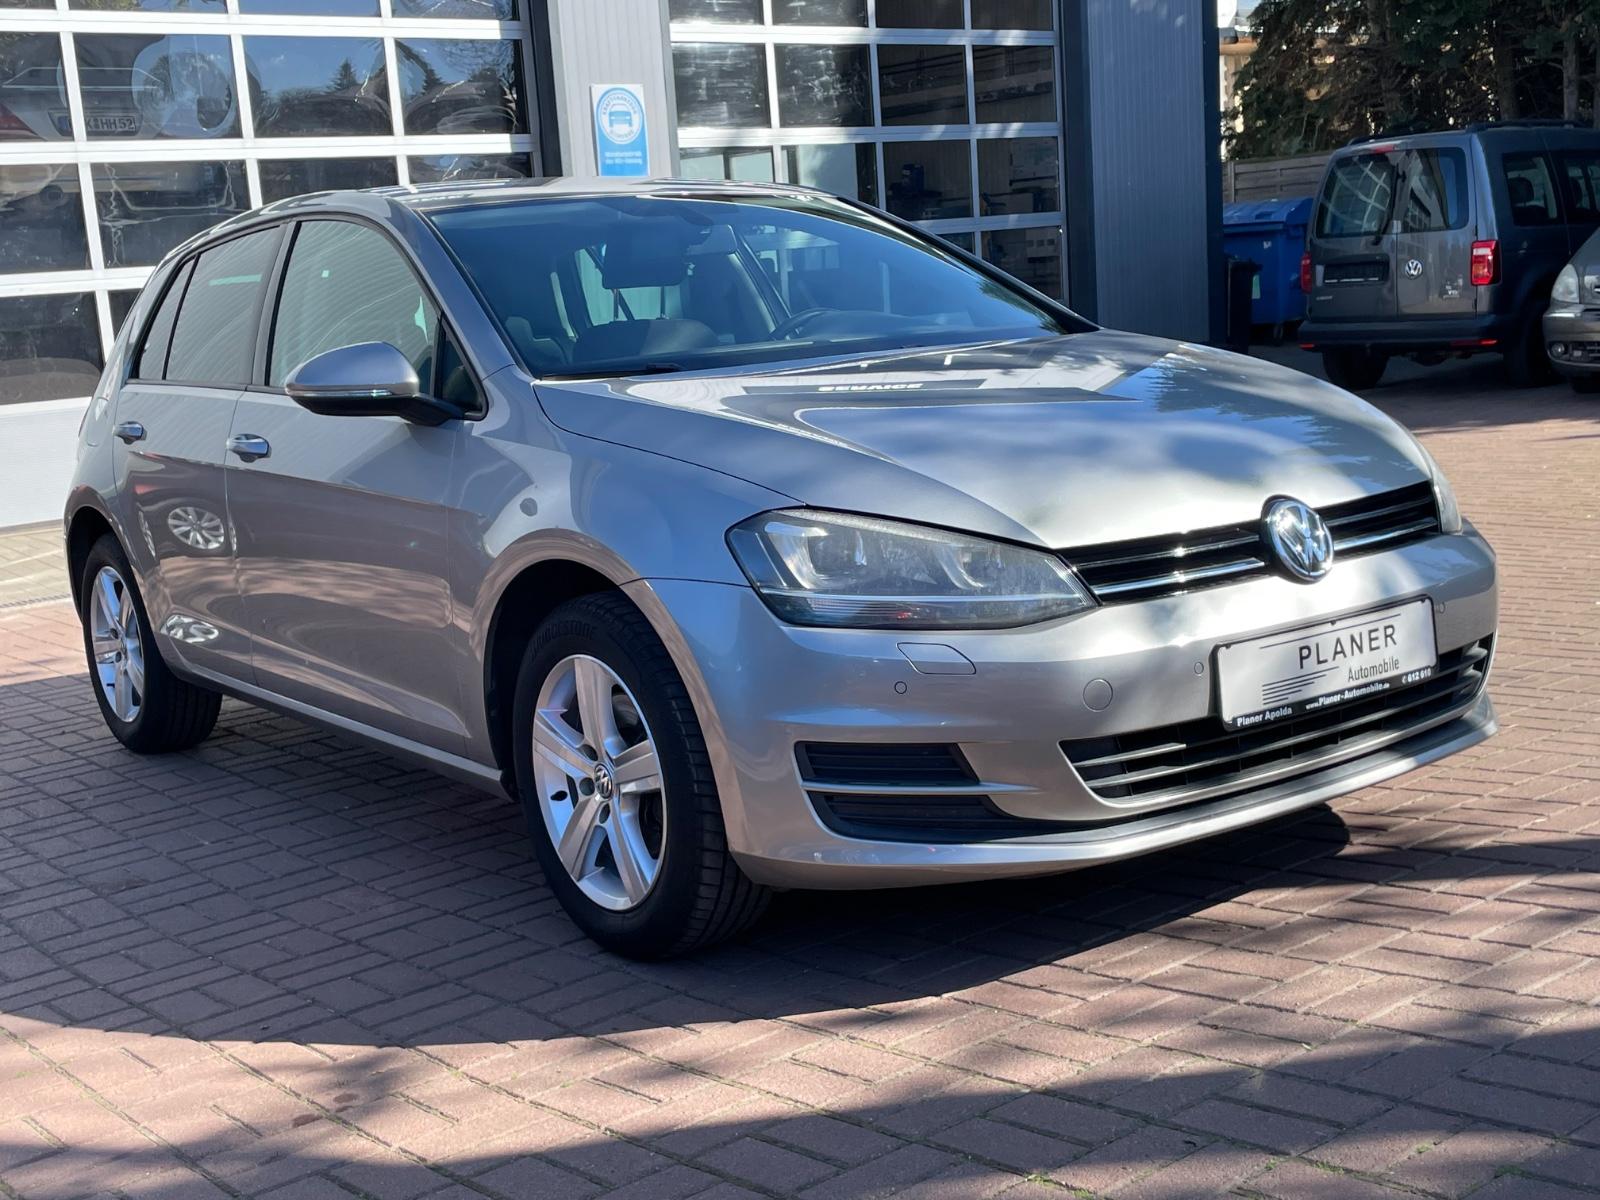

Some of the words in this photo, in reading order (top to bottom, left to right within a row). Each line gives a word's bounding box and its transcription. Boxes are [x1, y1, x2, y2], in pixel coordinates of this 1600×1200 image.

[1298, 624, 1398, 669] PLANER
[1347, 656, 1400, 682] Automobile
[1236, 713, 1263, 727] Planer
[1264, 706, 1293, 720] Apolda
[1305, 682, 1391, 710] www.Planer-Automobile.de
